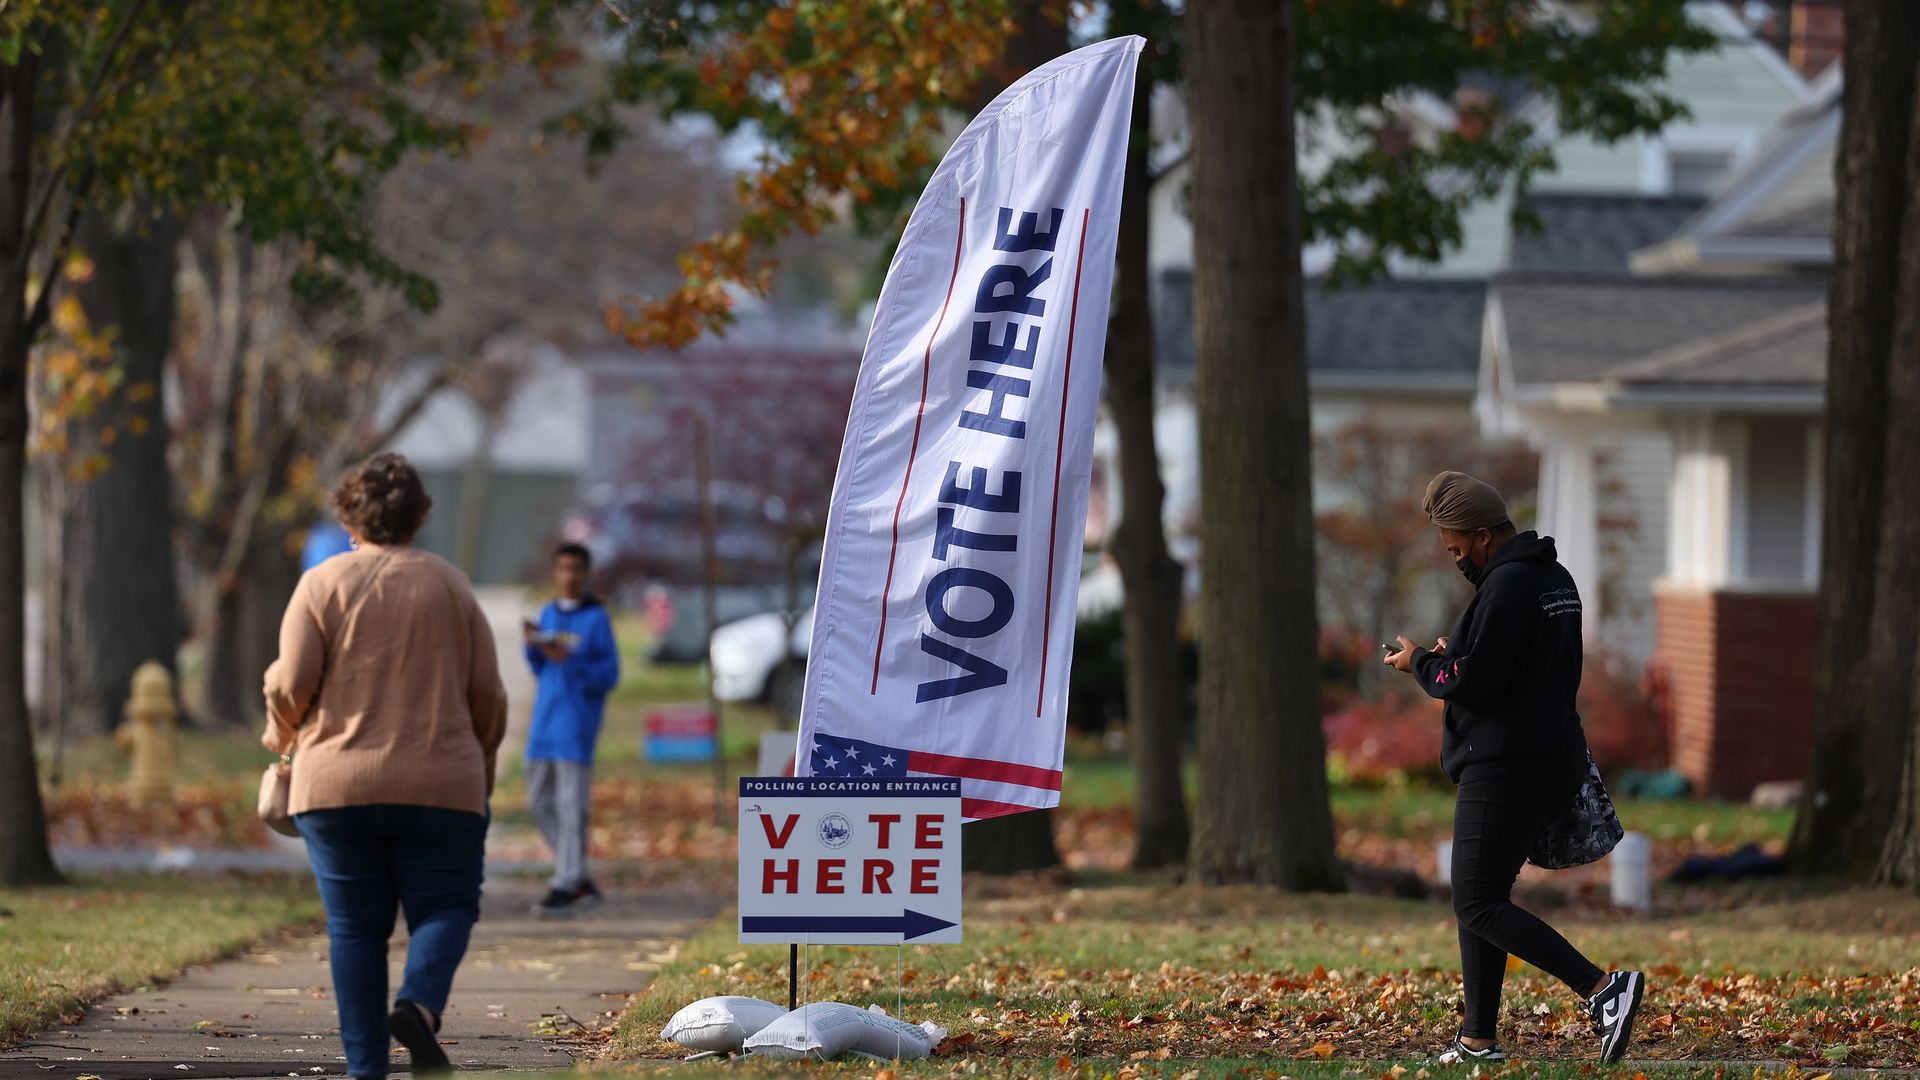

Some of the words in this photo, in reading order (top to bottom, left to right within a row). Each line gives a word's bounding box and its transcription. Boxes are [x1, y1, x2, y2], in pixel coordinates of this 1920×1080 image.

[958, 206, 1064, 439] HERE
[916, 460, 1021, 704] VOTE
[746, 782, 805, 791] POLLING
[810, 782, 880, 791] LOCATION
[886, 782, 958, 791] ENTRANCE
[761, 859, 940, 894] HERE
